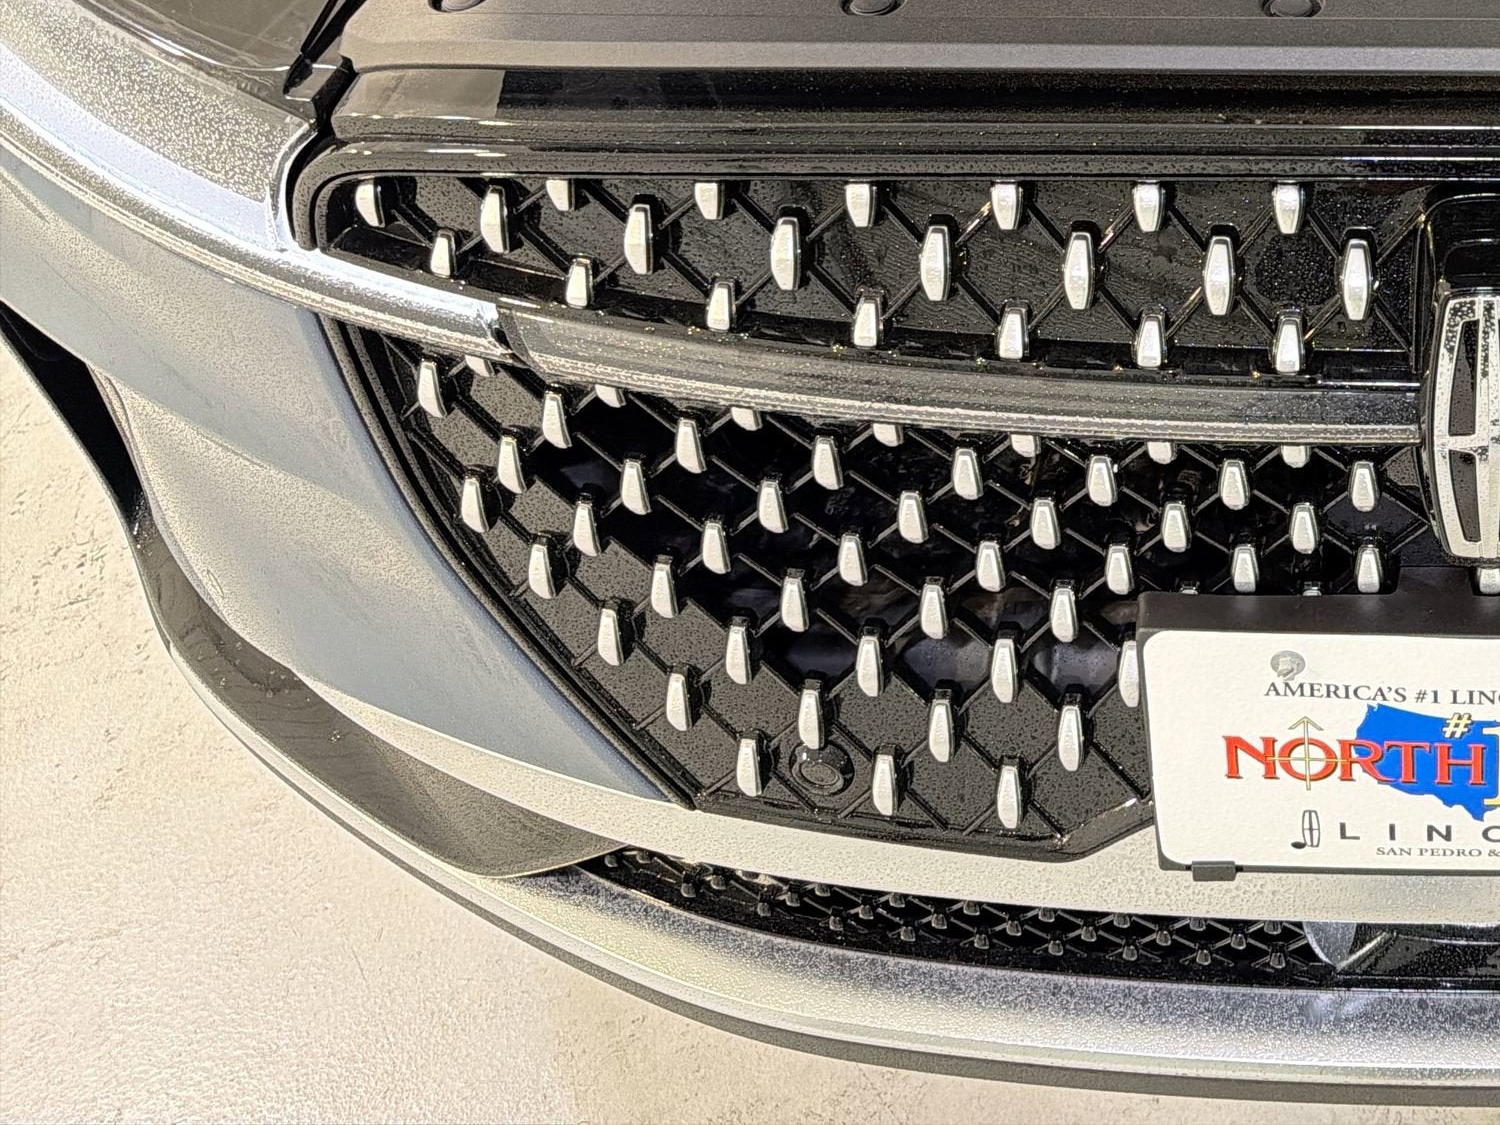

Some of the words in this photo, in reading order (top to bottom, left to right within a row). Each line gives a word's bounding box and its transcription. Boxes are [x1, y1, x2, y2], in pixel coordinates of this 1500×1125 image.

[1264, 681, 1409, 704] AMERICA'S
[1414, 689, 1441, 705] #1
[1221, 735, 1487, 787] NORTH
[1375, 845, 1414, 858] SAN
[1418, 845, 1483, 858] PEDRO
